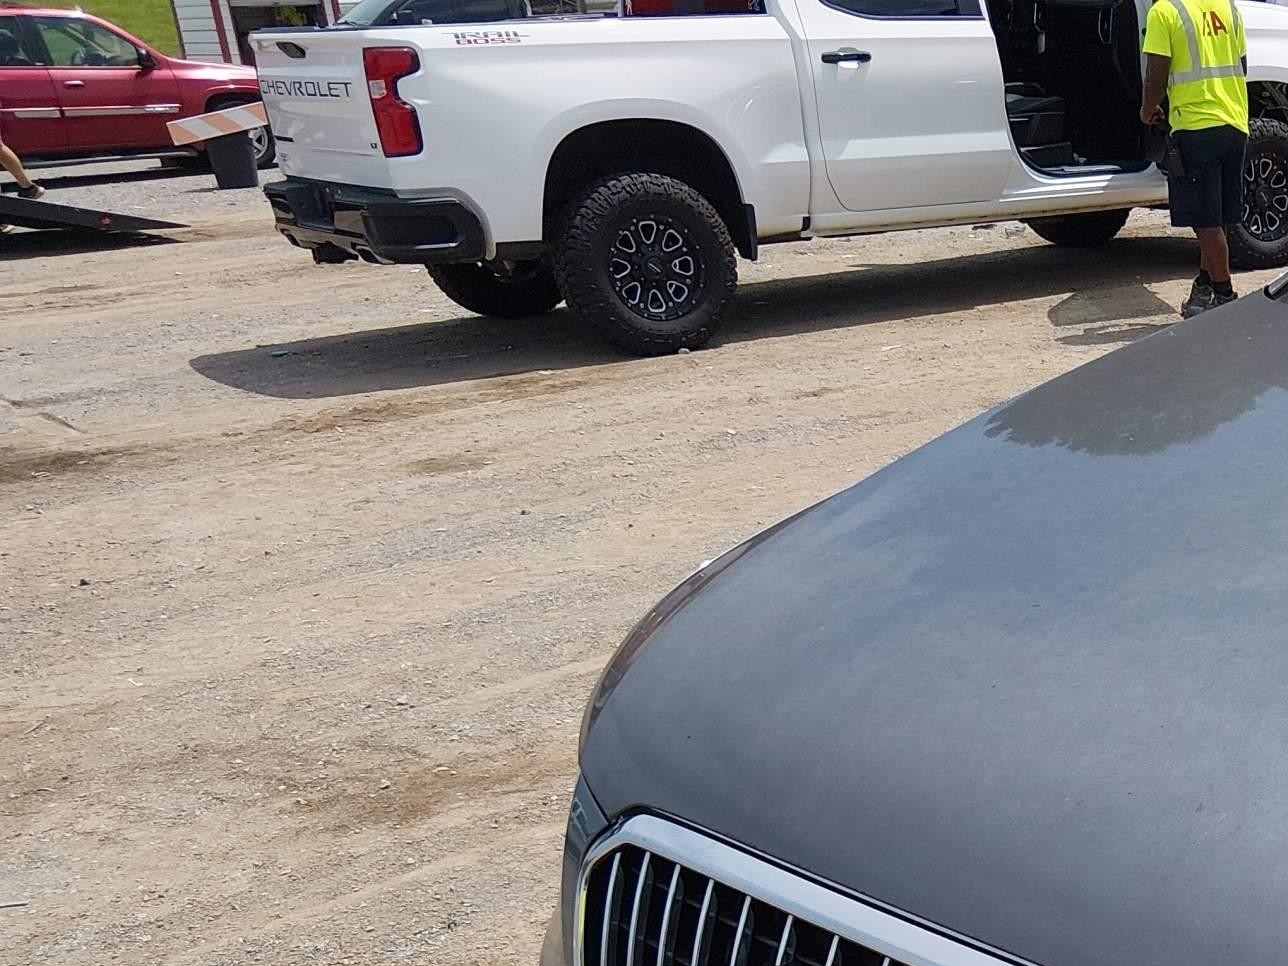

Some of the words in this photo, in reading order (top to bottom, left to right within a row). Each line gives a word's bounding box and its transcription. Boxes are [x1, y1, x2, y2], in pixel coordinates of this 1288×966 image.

[441, 30, 531, 39] TRAIL
[455, 37, 521, 45] BOSS
[260, 79, 353, 98] CHEVROLET
